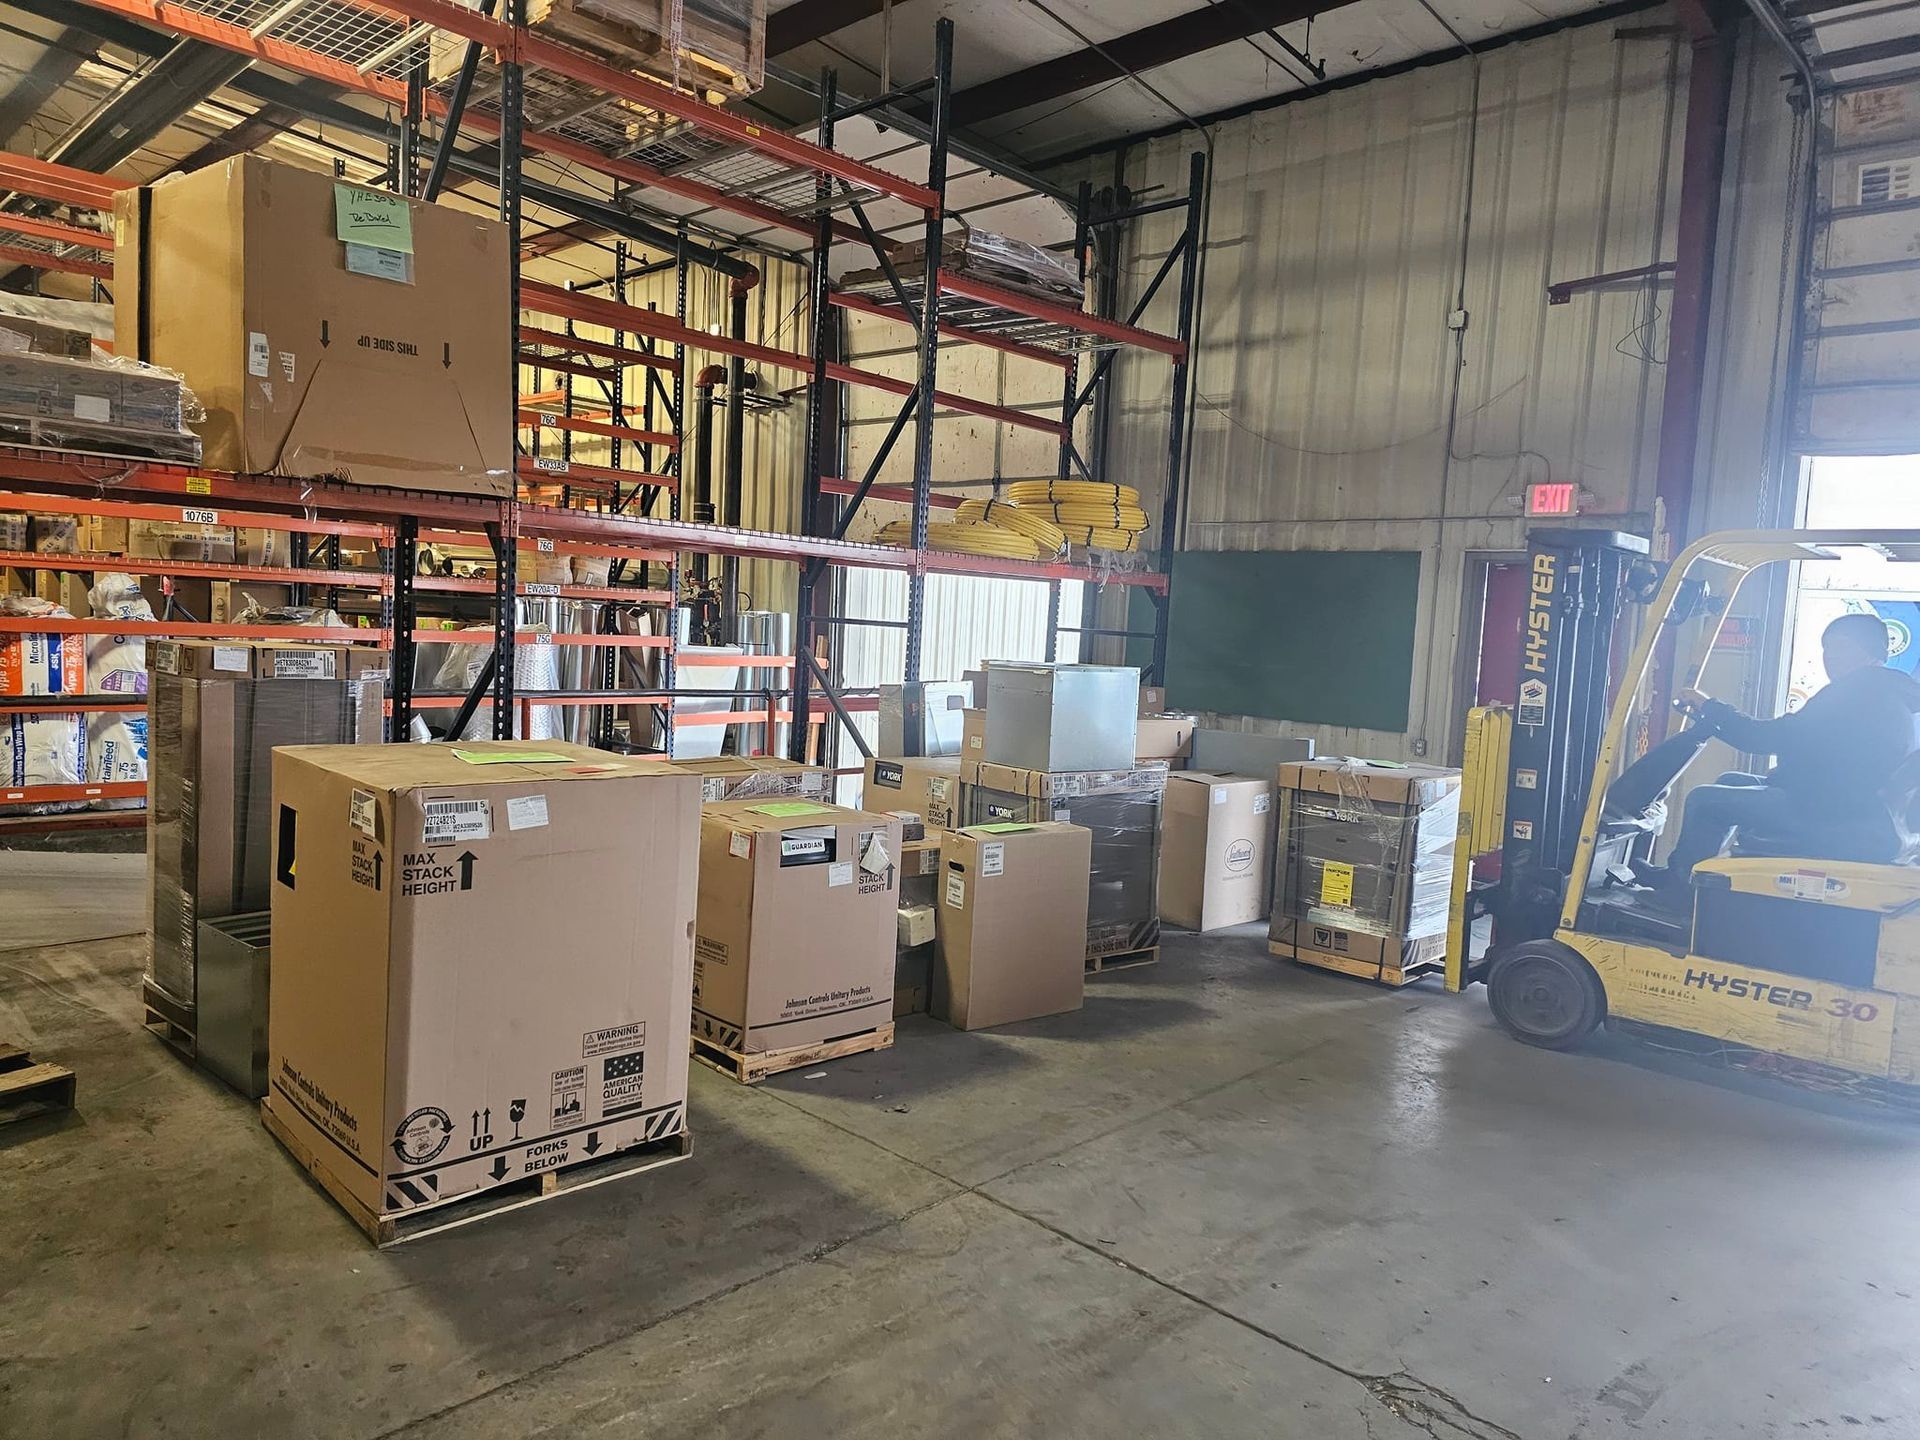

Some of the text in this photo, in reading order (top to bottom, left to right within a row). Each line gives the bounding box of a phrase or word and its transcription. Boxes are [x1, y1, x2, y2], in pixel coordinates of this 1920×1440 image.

[358, 335, 418, 356] THIS SIDE UP
[542, 415, 556, 425] 76C
[1532, 484, 1573, 513] EXIT
[185, 510, 214, 522] 1076B
[1524, 554, 1556, 673] HYSTER
[14, 730, 23, 746] Wrap
[886, 770, 902, 782] YORK
[929, 802, 940, 811] MAX
[994, 807, 1014, 819] YORK
[928, 810, 945, 819] STACK
[928, 817, 946, 827] HEIGHT
[1335, 809, 1359, 823] YORK
[353, 840, 365, 852] MAX
[791, 841, 823, 850] GUARDIAN
[352, 856, 373, 872] STACK
[403, 853, 435, 866] MAX
[352, 871, 375, 889] HEIGHT
[402, 866, 454, 881] STACK
[858, 873, 884, 884] STACK
[402, 880, 457, 896] HEIGHT
[858, 883, 886, 895] HEIGHT
[785, 985, 871, 1009] Johnson Controls Unitary Products
[1683, 968, 1813, 1011] HYSTER
[1824, 999, 1879, 1022] 30
[596, 1025, 639, 1041] WARNING
[554, 1067, 584, 1080] CAUTION
[603, 1074, 644, 1090] AMERICAN
[602, 1082, 643, 1099] QUALITY
[334, 1100, 358, 1132] Products
[409, 1129, 430, 1138] Controls
[469, 1134, 494, 1151] UP
[526, 1139, 568, 1159] FORKS
[524, 1152, 569, 1173] BELOW
